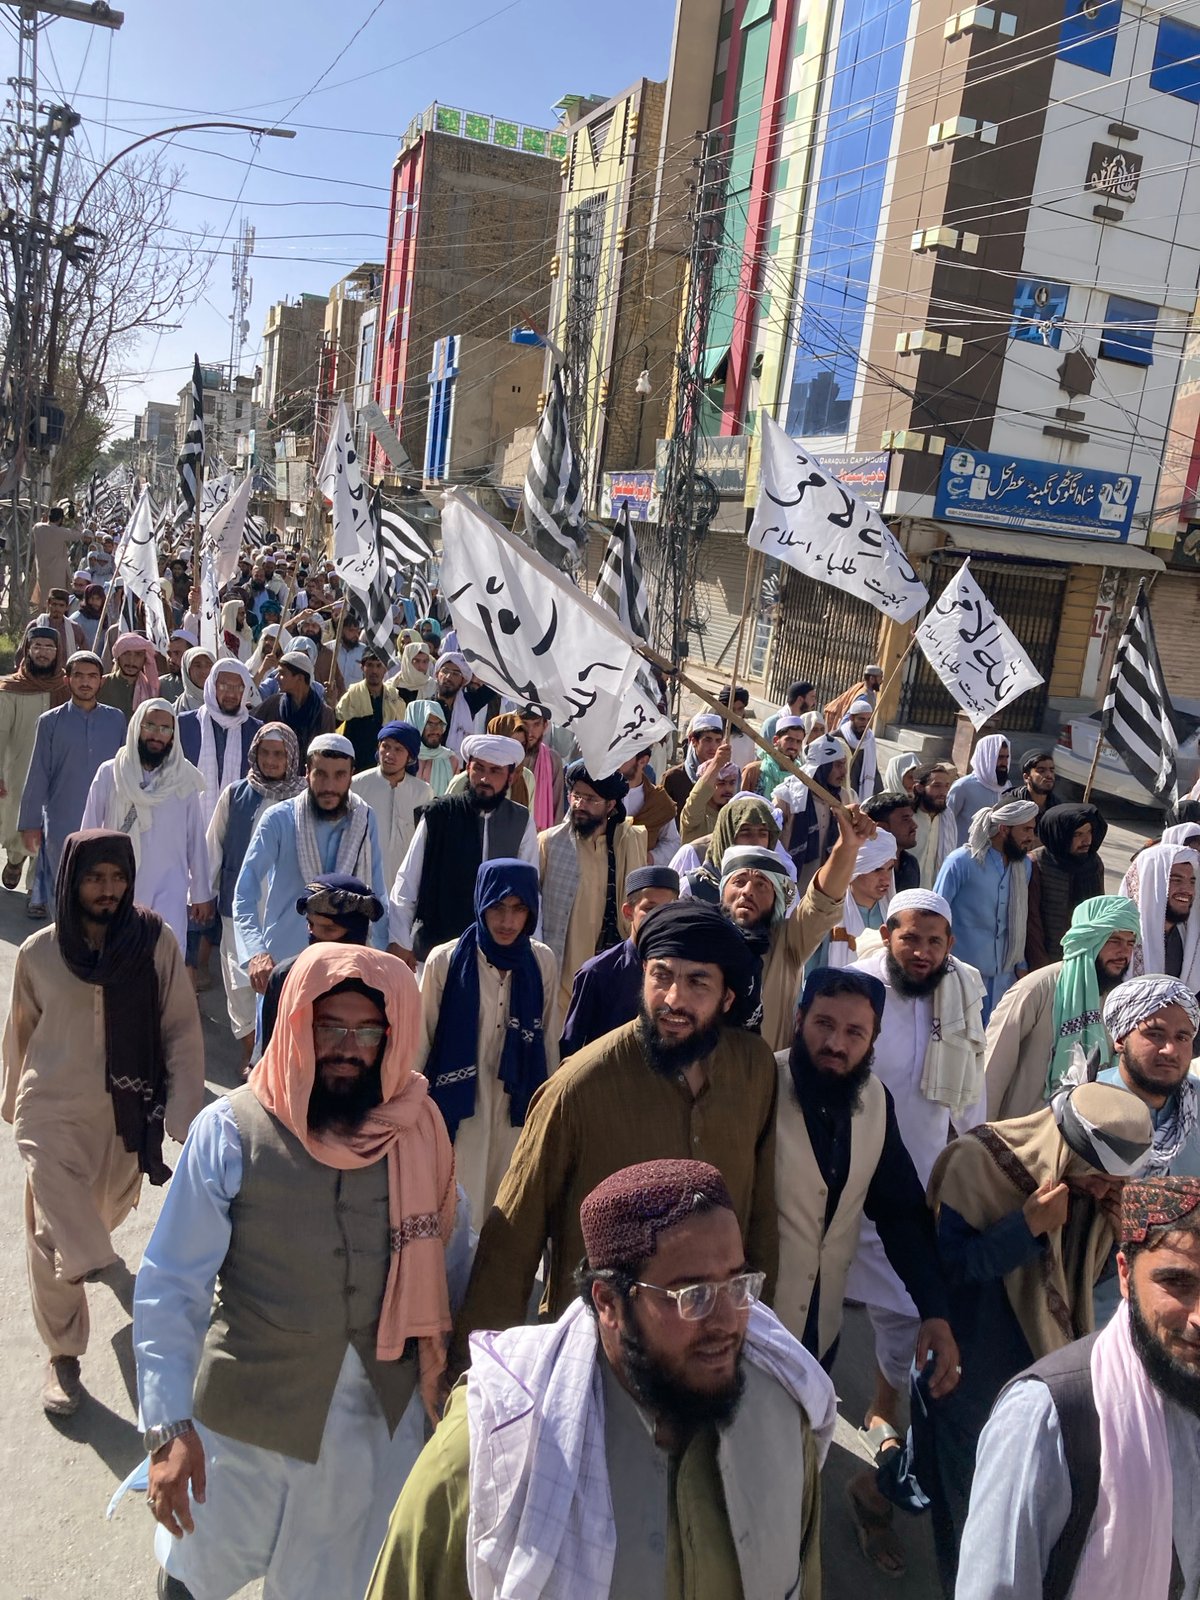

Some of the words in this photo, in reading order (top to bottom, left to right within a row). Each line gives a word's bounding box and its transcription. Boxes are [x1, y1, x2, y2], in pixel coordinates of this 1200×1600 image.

[865, 456, 888, 464] HOUSE
[987, 462, 1017, 497] محل
[995, 473, 1026, 500] عطر
[760, 527, 812, 554] اسلام
[815, 553, 857, 576] طلباء
[863, 577, 908, 609] جمعیت
[918, 624, 942, 649] اسلام
[938, 651, 962, 674] طلباء
[958, 680, 986, 716] جمعیت
